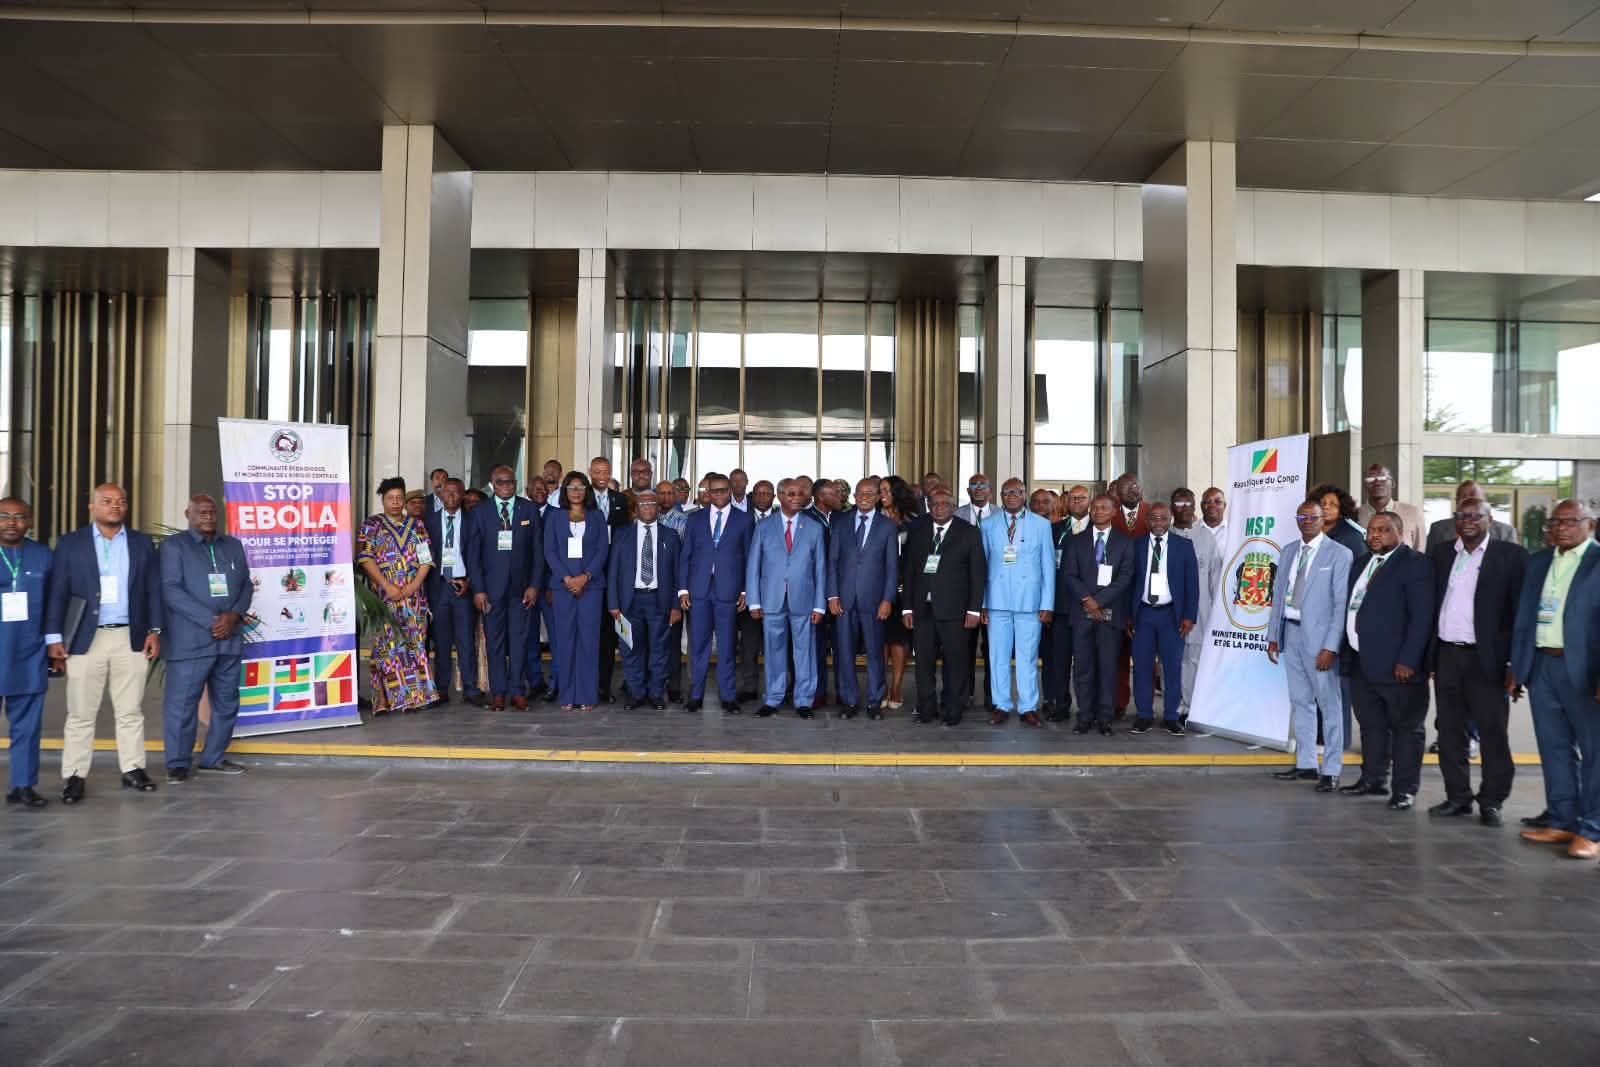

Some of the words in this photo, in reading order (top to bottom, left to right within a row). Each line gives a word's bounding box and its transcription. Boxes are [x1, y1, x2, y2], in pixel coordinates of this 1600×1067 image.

[1265, 476, 1275, 484] du
[1277, 475, 1299, 484] Congo
[263, 484, 313, 501] STOP
[238, 505, 337, 529] EBOLA
[1245, 516, 1275, 536] MSP
[241, 537, 271, 547] POUR
[273, 537, 287, 546] SE
[288, 535, 338, 545] PROTÉGER
[1248, 633, 1259, 641] DE
[1233, 641, 1242, 649] LA
[1244, 642, 1268, 652] POPUL
